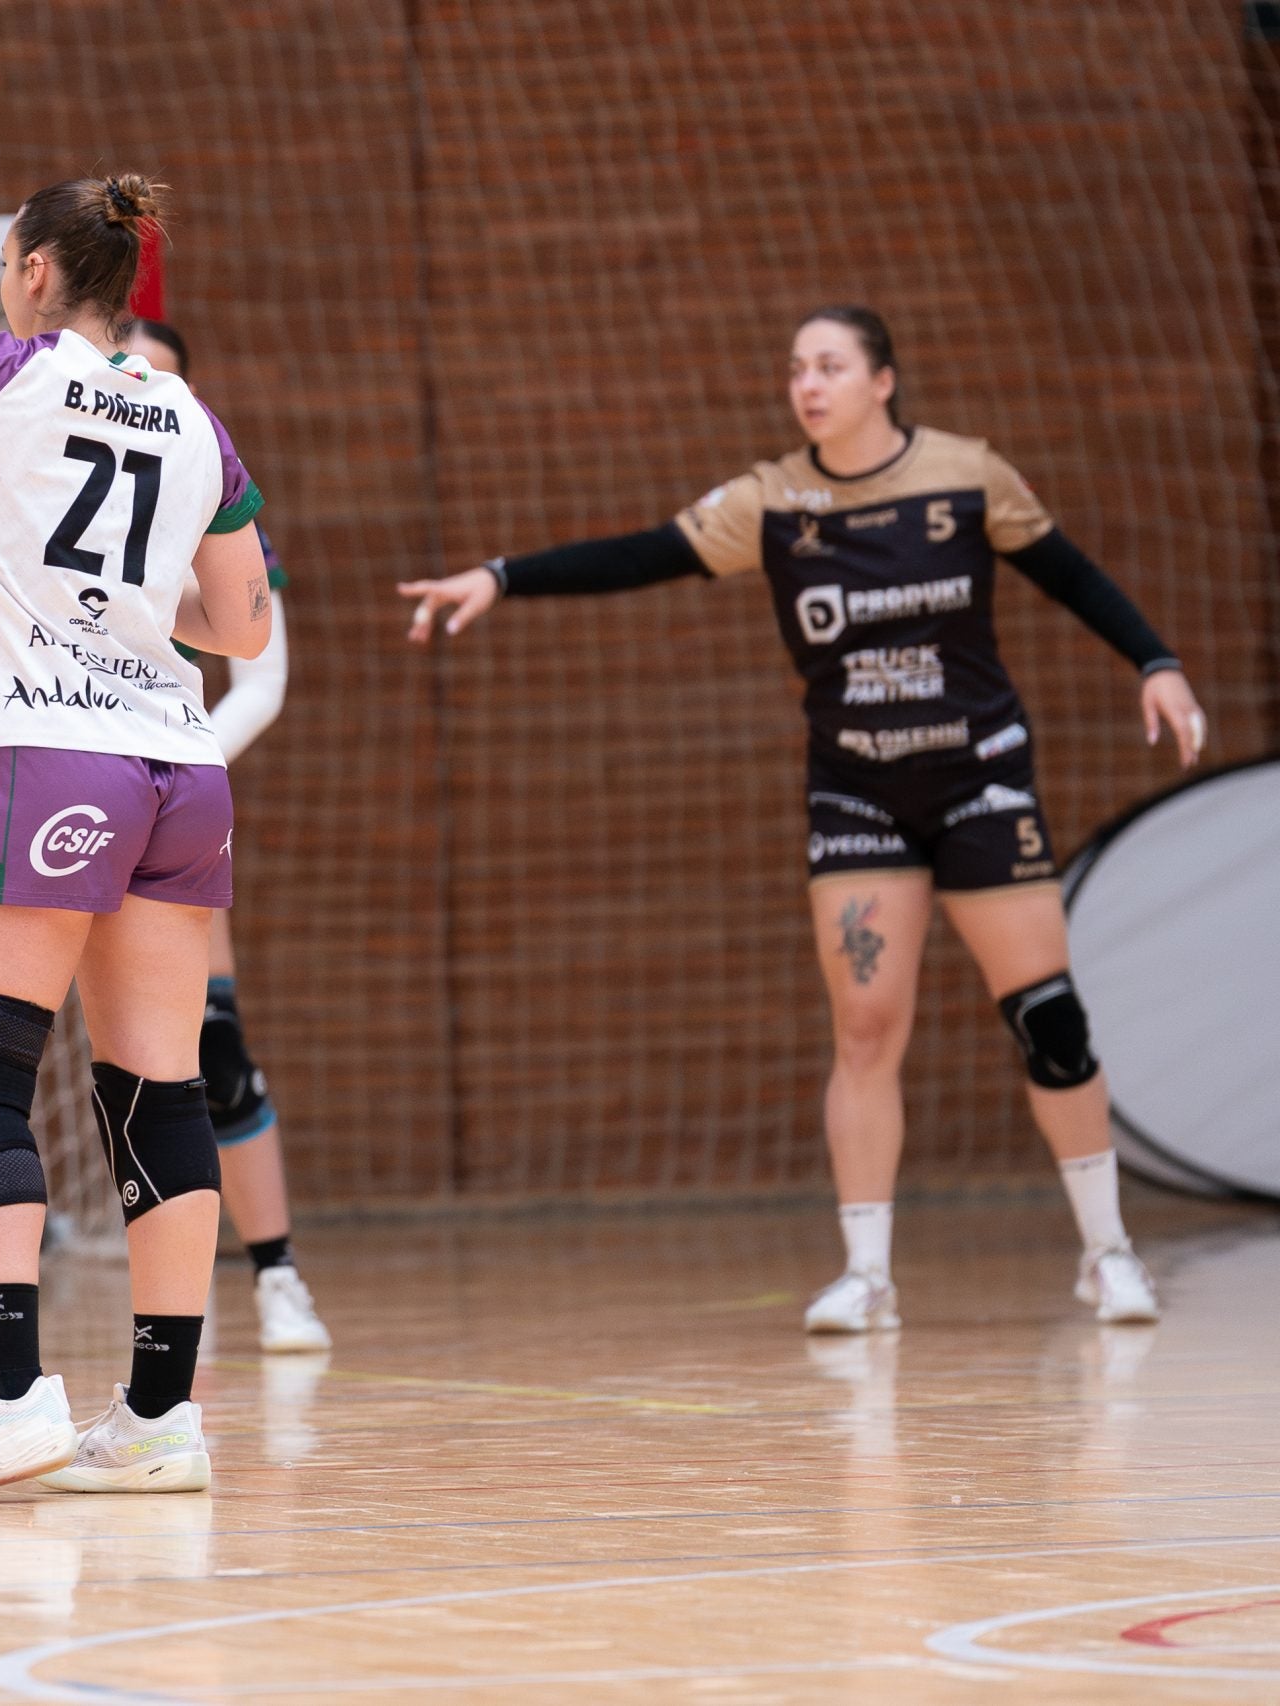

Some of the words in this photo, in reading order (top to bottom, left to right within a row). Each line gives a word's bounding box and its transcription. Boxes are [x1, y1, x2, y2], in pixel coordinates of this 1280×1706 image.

[64, 379, 88, 413] B.
[90, 388, 181, 436] PIÑEIRA
[42, 434, 163, 588] 21
[924, 499, 958, 543] 5
[46, 825, 116, 856] CSIF
[1015, 815, 1044, 858] 5
